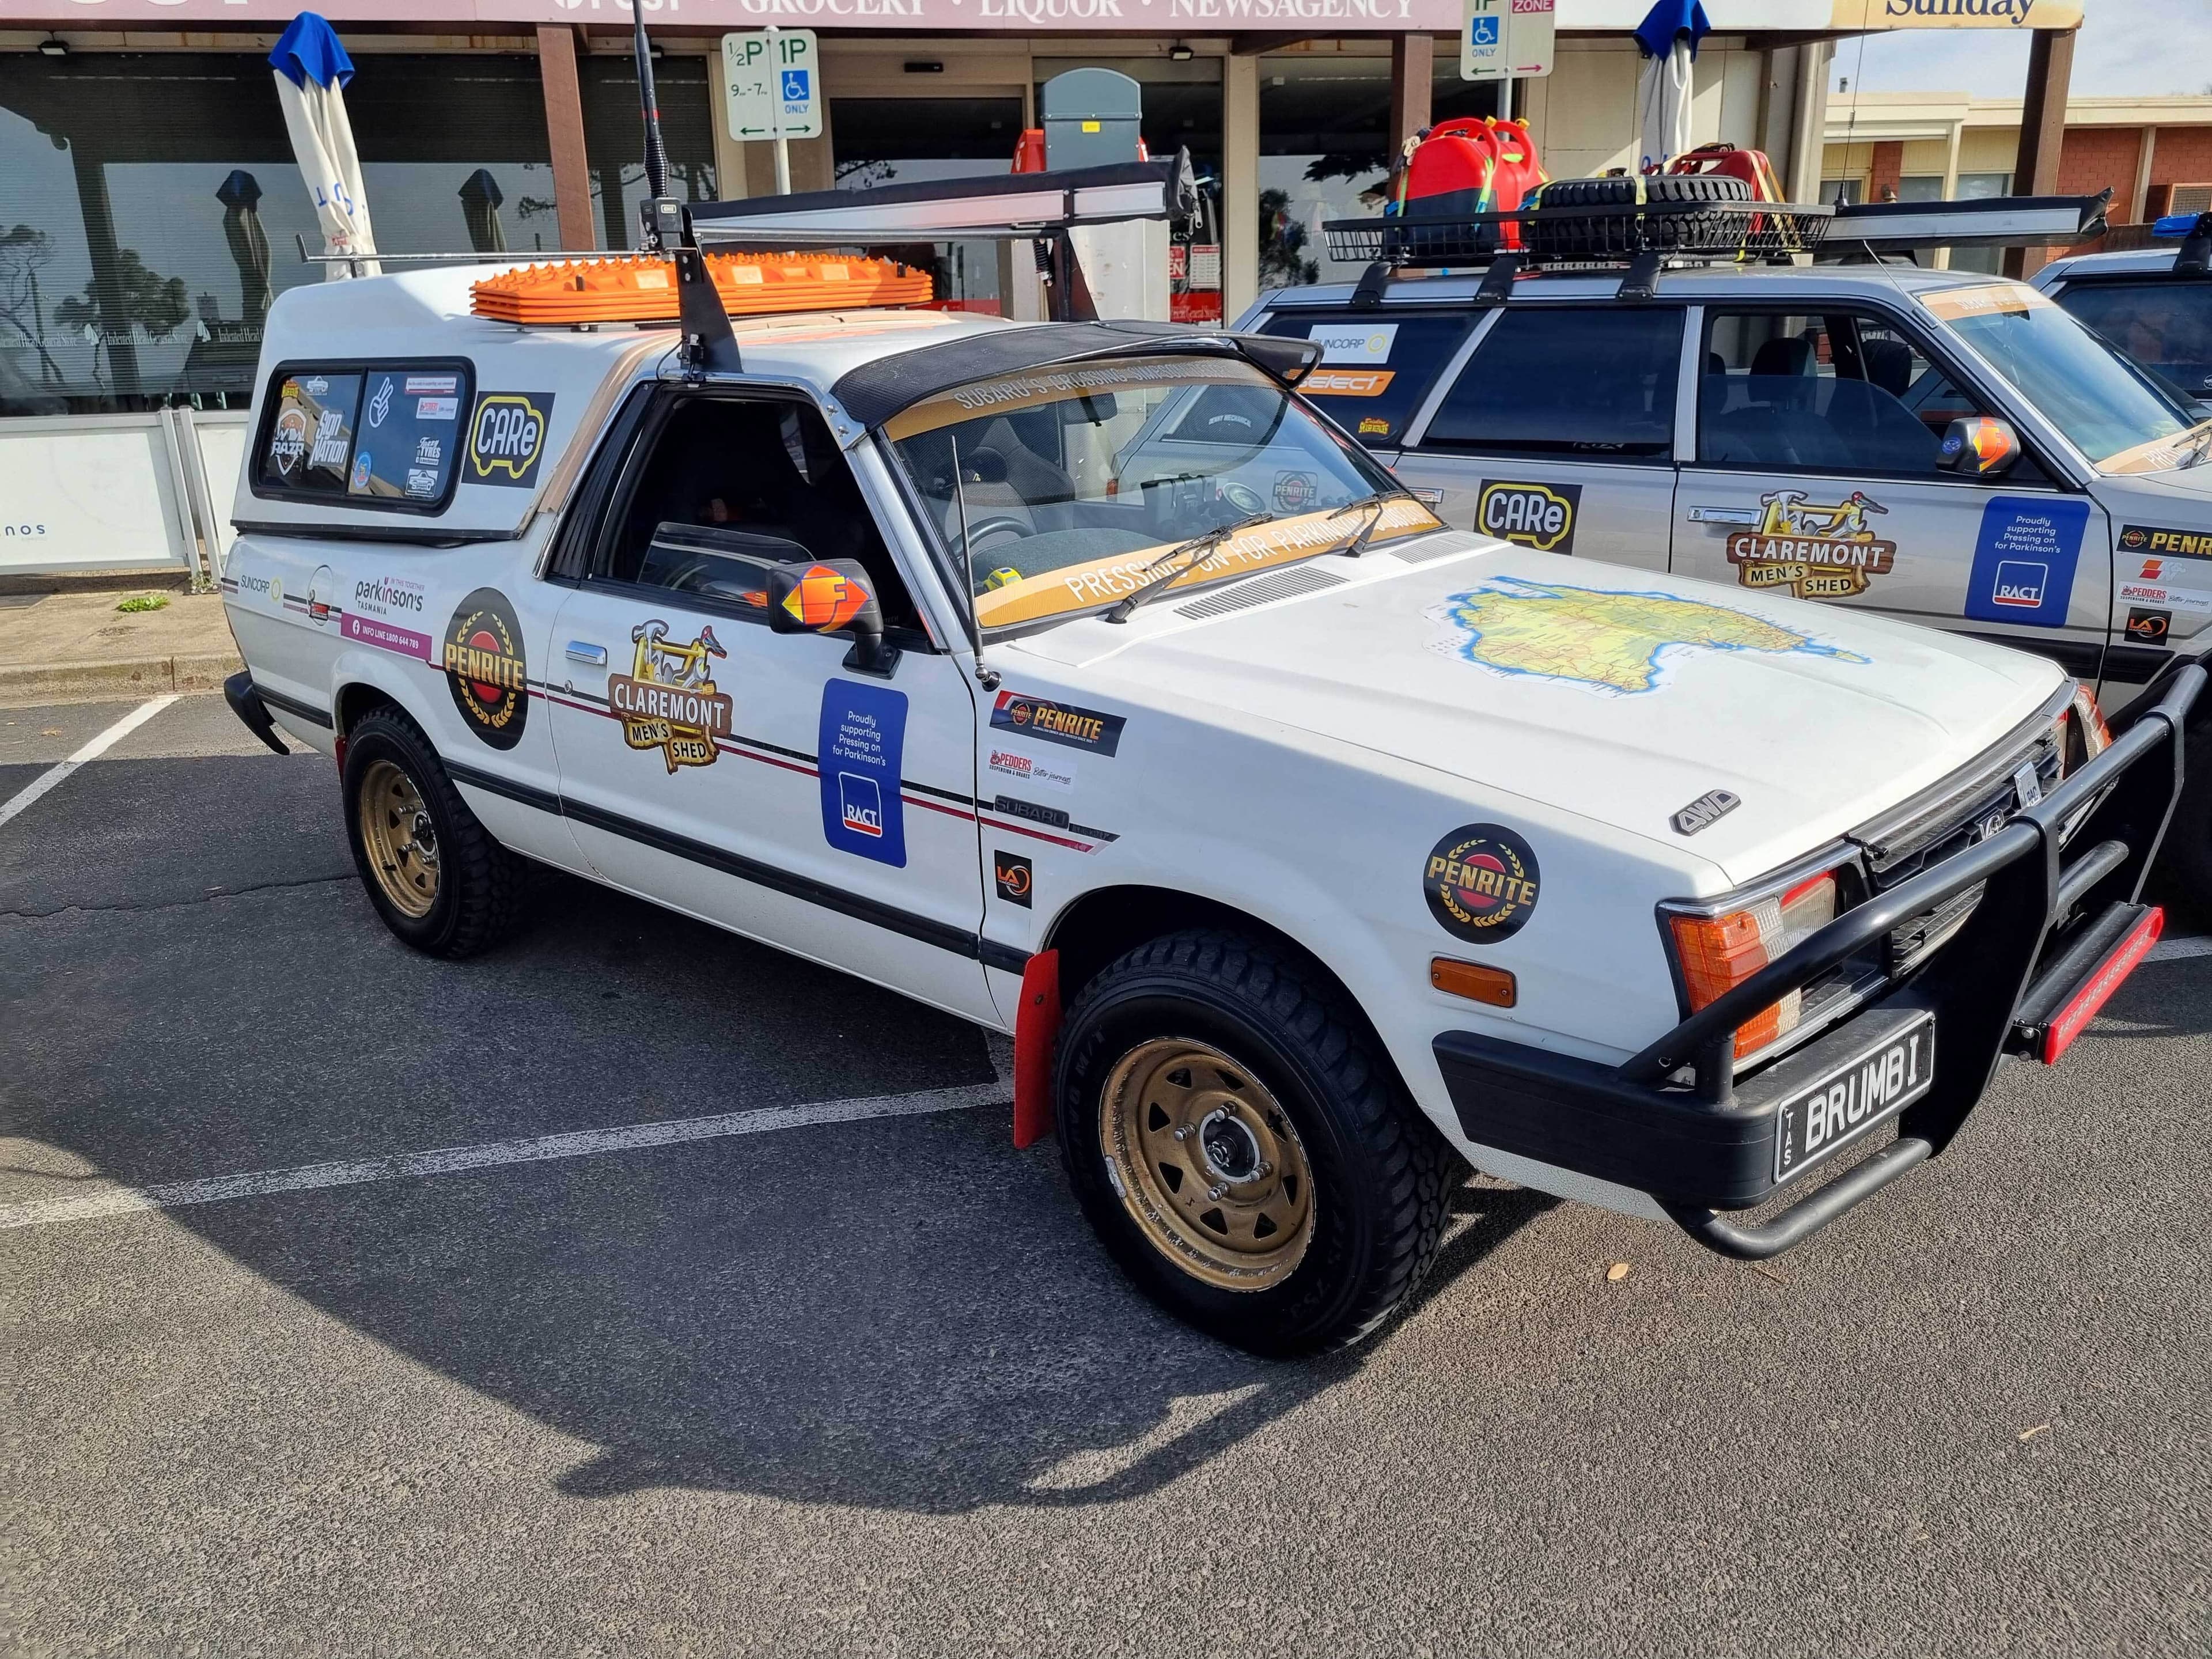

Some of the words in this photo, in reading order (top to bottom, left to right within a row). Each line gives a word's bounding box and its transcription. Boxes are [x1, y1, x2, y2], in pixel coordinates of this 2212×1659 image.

[779, 39, 806, 63] 1P
[1472, 48, 1496, 58] ONLY
[785, 104, 809, 114] ONLY
[1048, 367, 1128, 392] CROSSING
[478, 408, 537, 456] CARe
[421, 446, 441, 459] TYRES
[1275, 485, 1315, 498] PENRITE
[1487, 493, 1564, 533] CARe
[2016, 516, 2051, 527] Proudly
[2003, 533, 2041, 544] Pressing
[2006, 525, 2056, 536] supporting
[2122, 534, 2148, 543] PENRITE
[1227, 533, 1278, 564] FOR
[1734, 537, 1885, 567] CLAREMONT
[1994, 541, 2008, 550] for
[2009, 543, 2061, 554] Parkinson's
[1751, 565, 1804, 582] MEN'S
[240, 574, 270, 593] SUNCORP
[1805, 578, 1851, 592] SHED
[2000, 585, 2038, 600] RACT
[2132, 586, 2167, 600] PEDDERS
[355, 579, 423, 612] parkinson's
[357, 600, 387, 615] TASMANIA
[362, 626, 374, 637] INFO
[375, 628, 386, 639] LINE
[386, 632, 399, 643] 1800
[399, 636, 408, 646] 644
[409, 638, 419, 649] 789
[445, 642, 524, 692] PENRITE
[614, 683, 725, 729] CLAREMONT
[848, 710, 877, 728] Proudly
[1011, 709, 1033, 719] PENRITE
[1033, 707, 1104, 740] PENRITE
[633, 722, 669, 742] MEN'S
[840, 724, 881, 743] supporting
[672, 741, 707, 759] SHED
[839, 733, 869, 753] Pressing
[871, 743, 881, 753] on
[832, 744, 843, 756] for
[844, 748, 887, 767] Parkinson's
[1000, 753, 1032, 772] PEDDERS
[1033, 767, 1049, 778] Better
[846, 804, 877, 827] RACT
[996, 797, 1067, 826] SUBARU
[1679, 790, 1740, 832] 4WD
[1427, 856, 1536, 906] PENRITE
[1783, 1112, 1794, 1166] TAS
